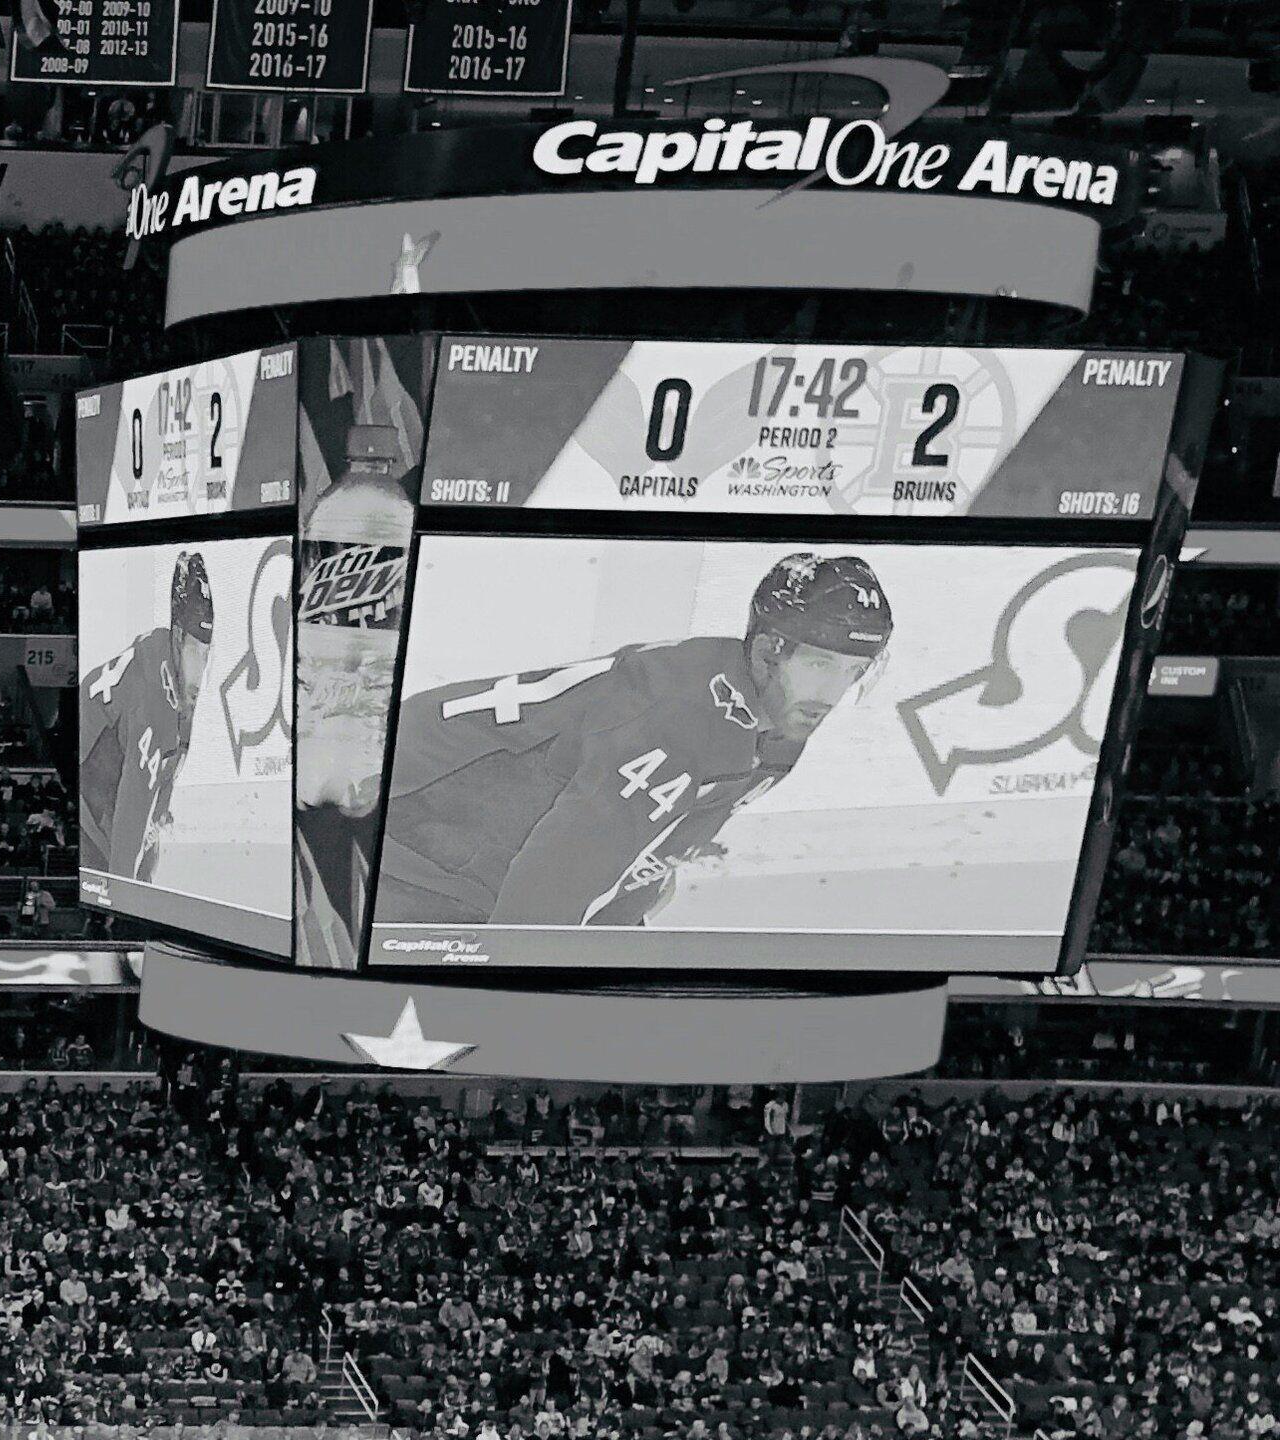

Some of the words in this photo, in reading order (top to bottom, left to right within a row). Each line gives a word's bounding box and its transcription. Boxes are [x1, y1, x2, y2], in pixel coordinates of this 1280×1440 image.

[101, 21, 148, 36] 2010-11
[252, 23, 326, 48] 2015-16
[452, 25, 527, 49] 2015-16
[100, 40, 148, 56] 2012-13
[40, 57, 89, 73] 2008-09
[249, 53, 326, 79] 2016-17
[448, 55, 526, 80] 2016-17
[958, 140, 1117, 205] Arena
[172, 167, 316, 227] Arena
[448, 344, 539, 375] PENALTY
[1080, 358, 1173, 388] PENALTY
[748, 354, 870, 420] 17:42
[210, 391, 224, 468] 2
[644, 378, 695, 464] 0
[911, 381, 964, 467] 2
[131, 407, 144, 480] 0
[757, 424, 818, 448] PERIOD
[825, 425, 838, 448] 2
[762, 456, 844, 490] Sports
[430, 478, 494, 504] SHOTS:
[618, 474, 700, 500] CAPITALS
[726, 482, 834, 498] WASHINGTON
[892, 478, 958, 503] BRUINS
[1057, 490, 1116, 515] SHOTS:
[1118, 492, 1144, 515] 16
[855, 588, 880, 608] 44
[27, 650, 54, 665] 215
[1159, 665, 1206, 677] CUSTOM
[1159, 677, 1178, 686] INK
[139, 726, 159, 791] 44
[618, 747, 692, 822] 44
[441, 952, 490, 963] Arena
